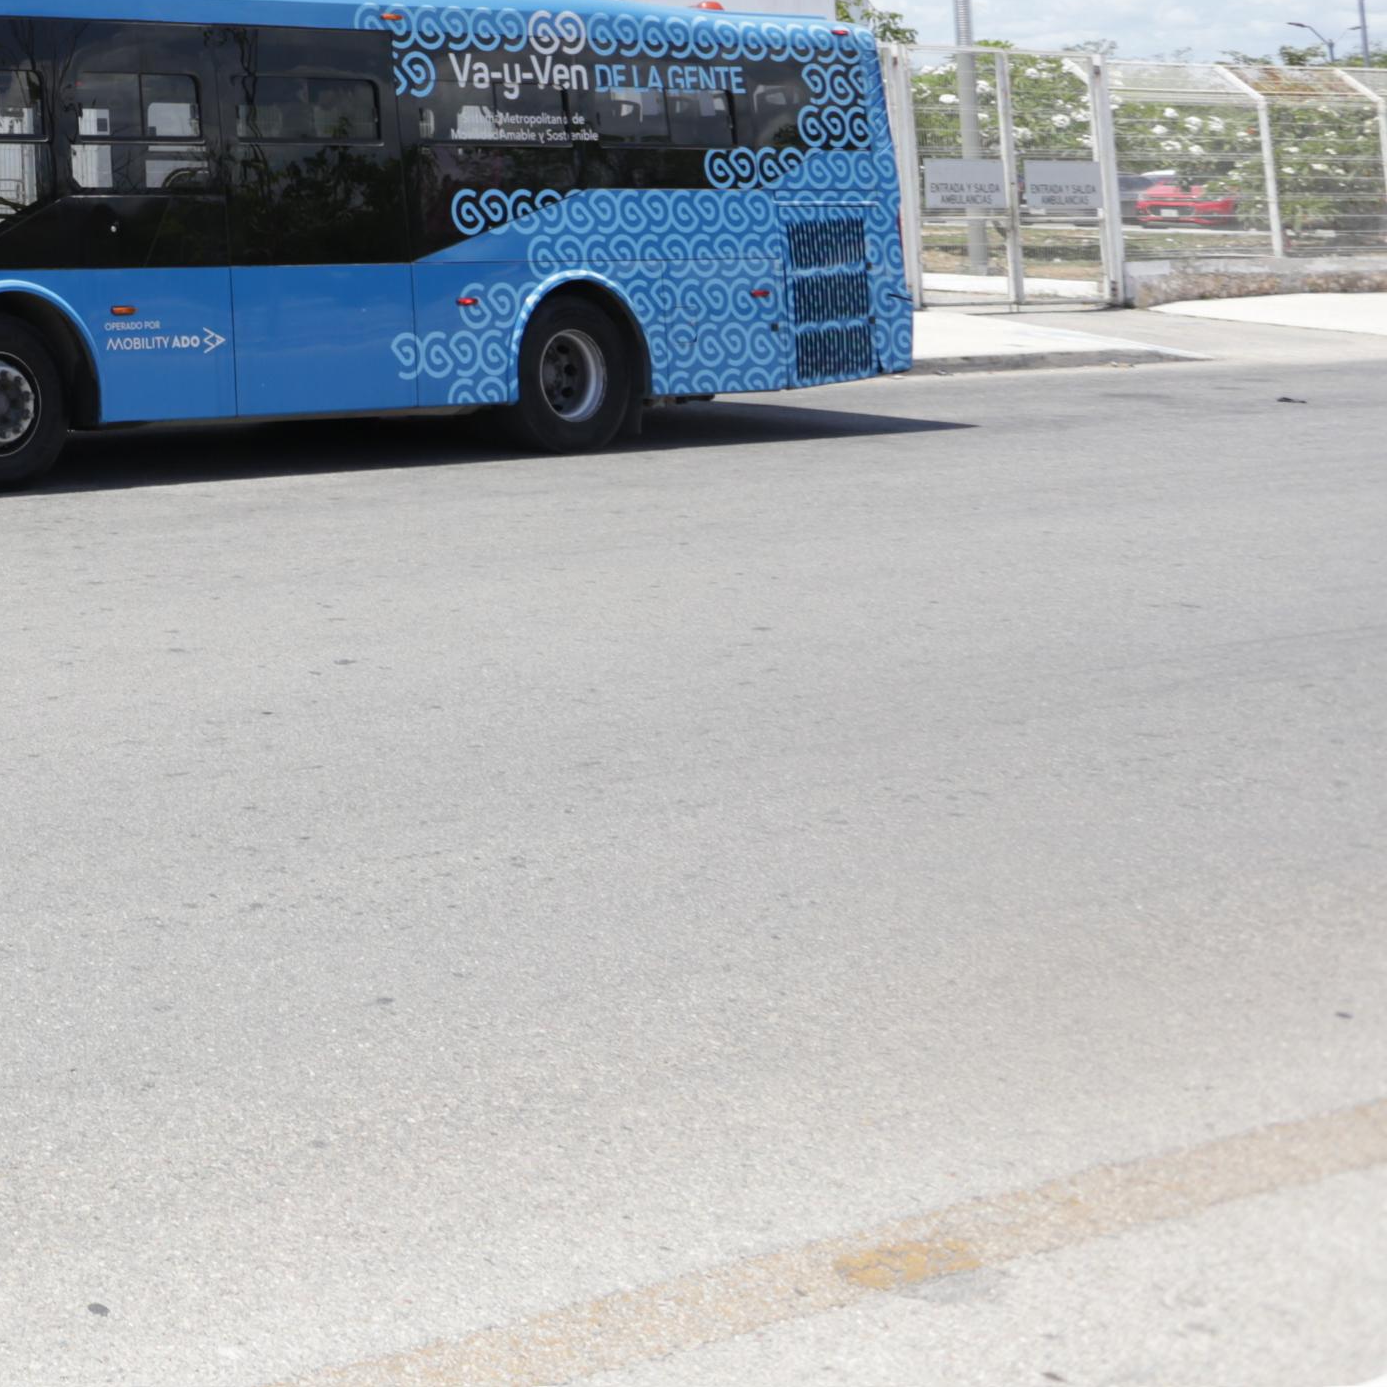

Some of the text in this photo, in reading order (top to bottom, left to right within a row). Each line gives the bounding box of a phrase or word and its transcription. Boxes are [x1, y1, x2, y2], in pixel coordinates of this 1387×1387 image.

[448, 52, 747, 100] Va-y-Ven DE LA GENTE
[572, 112, 585, 125] de
[499, 128, 537, 141] Amable
[104, 320, 161, 332] OPERADO POR
[106, 335, 201, 351] MOBILITY ADO
